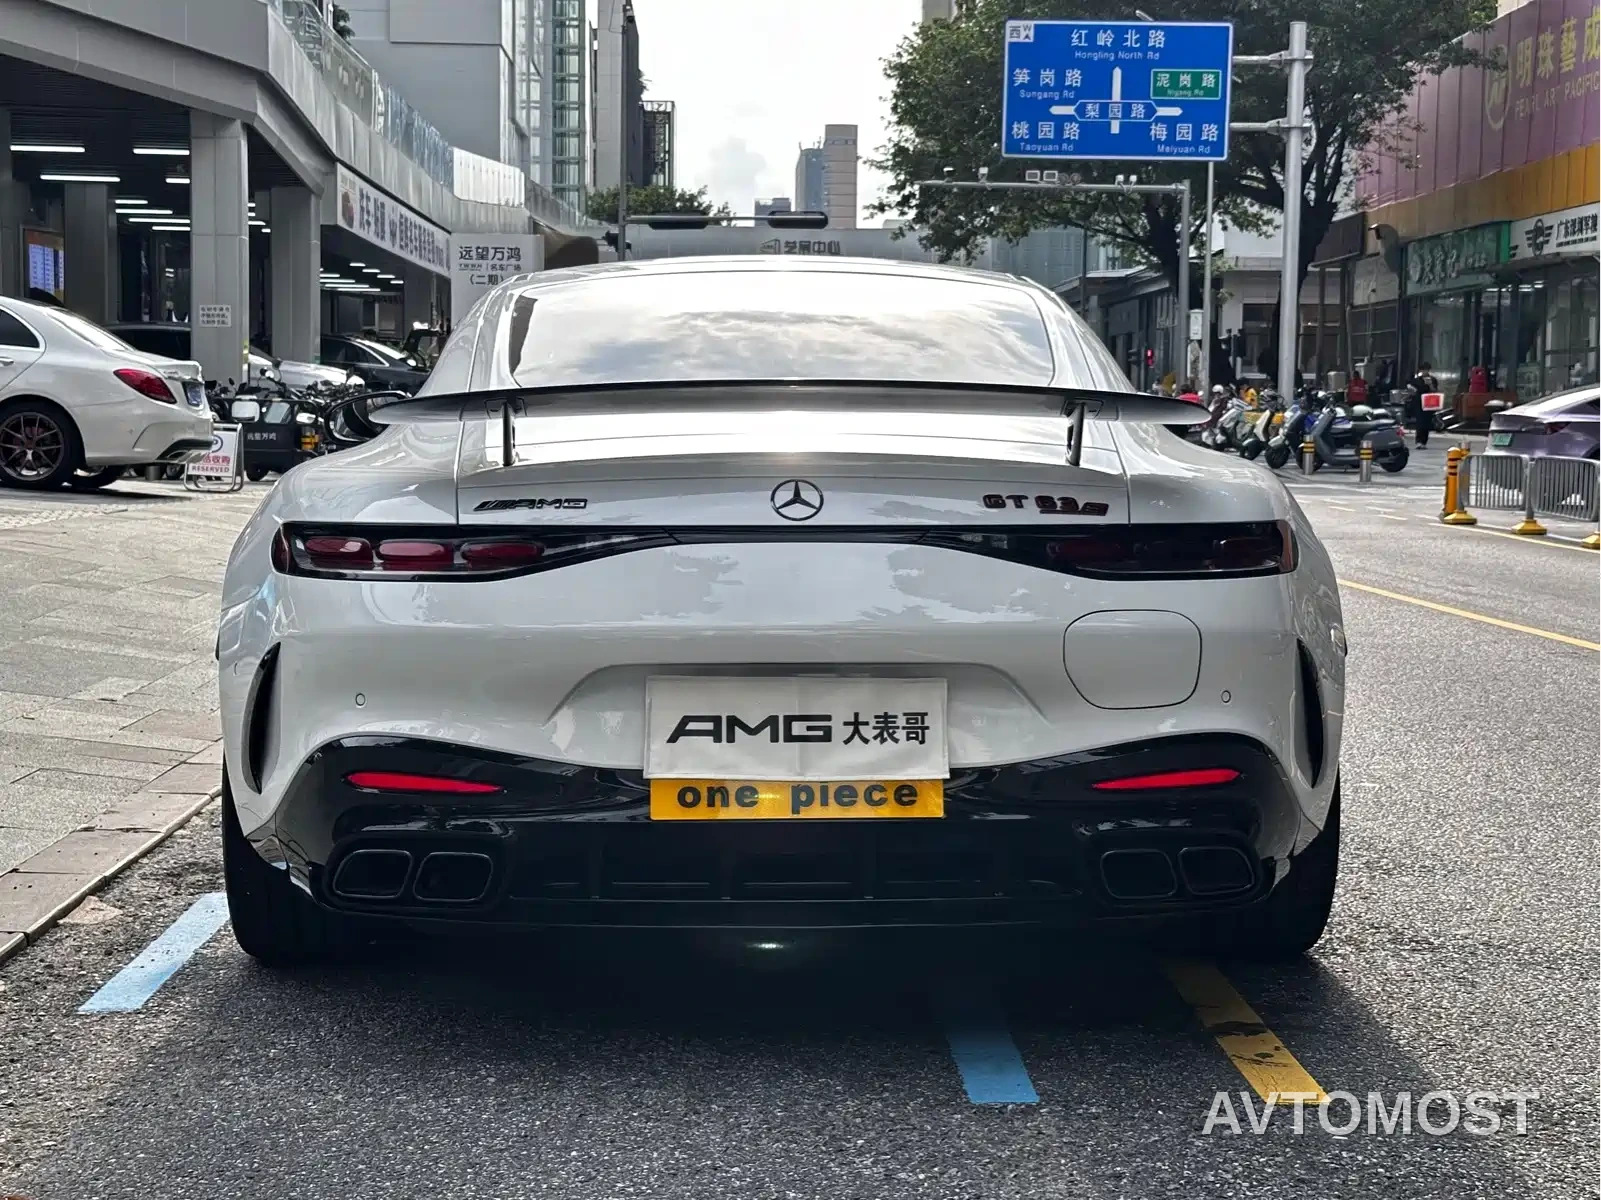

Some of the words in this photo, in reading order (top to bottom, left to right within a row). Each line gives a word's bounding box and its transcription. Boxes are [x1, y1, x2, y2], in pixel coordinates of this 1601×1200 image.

[1009, 26, 1021, 39] 西
[1022, 24, 1031, 32] W
[1071, 29, 1166, 48] 红岭北路
[1075, 51, 1115, 61] Hongling
[1118, 51, 1142, 60] North
[1147, 51, 1160, 60] Rd
[1013, 68, 1083, 87] 笋岗路
[1156, 73, 1216, 88] 泥岗路
[1019, 90, 1059, 100] Sungang
[1062, 90, 1075, 99] Rd
[1085, 103, 1146, 119] 梨园路
[1011, 121, 1081, 141] 桃园路
[1149, 123, 1219, 142] 梅园路
[1020, 143, 1059, 153] Taoyuan
[1062, 143, 1074, 152] Rd
[1157, 145, 1195, 155] Meiyuan
[1198, 145, 1211, 154] Rd
[459, 246, 521, 261] 远望万鸿
[191, 465, 230, 473] RESERVED
[500, 499, 587, 510] AMG
[982, 494, 1028, 509] GT
[666, 714, 832, 744] AMG
[843, 711, 930, 745] 大表哥
[677, 784, 760, 809] one
[791, 783, 919, 815] piece
